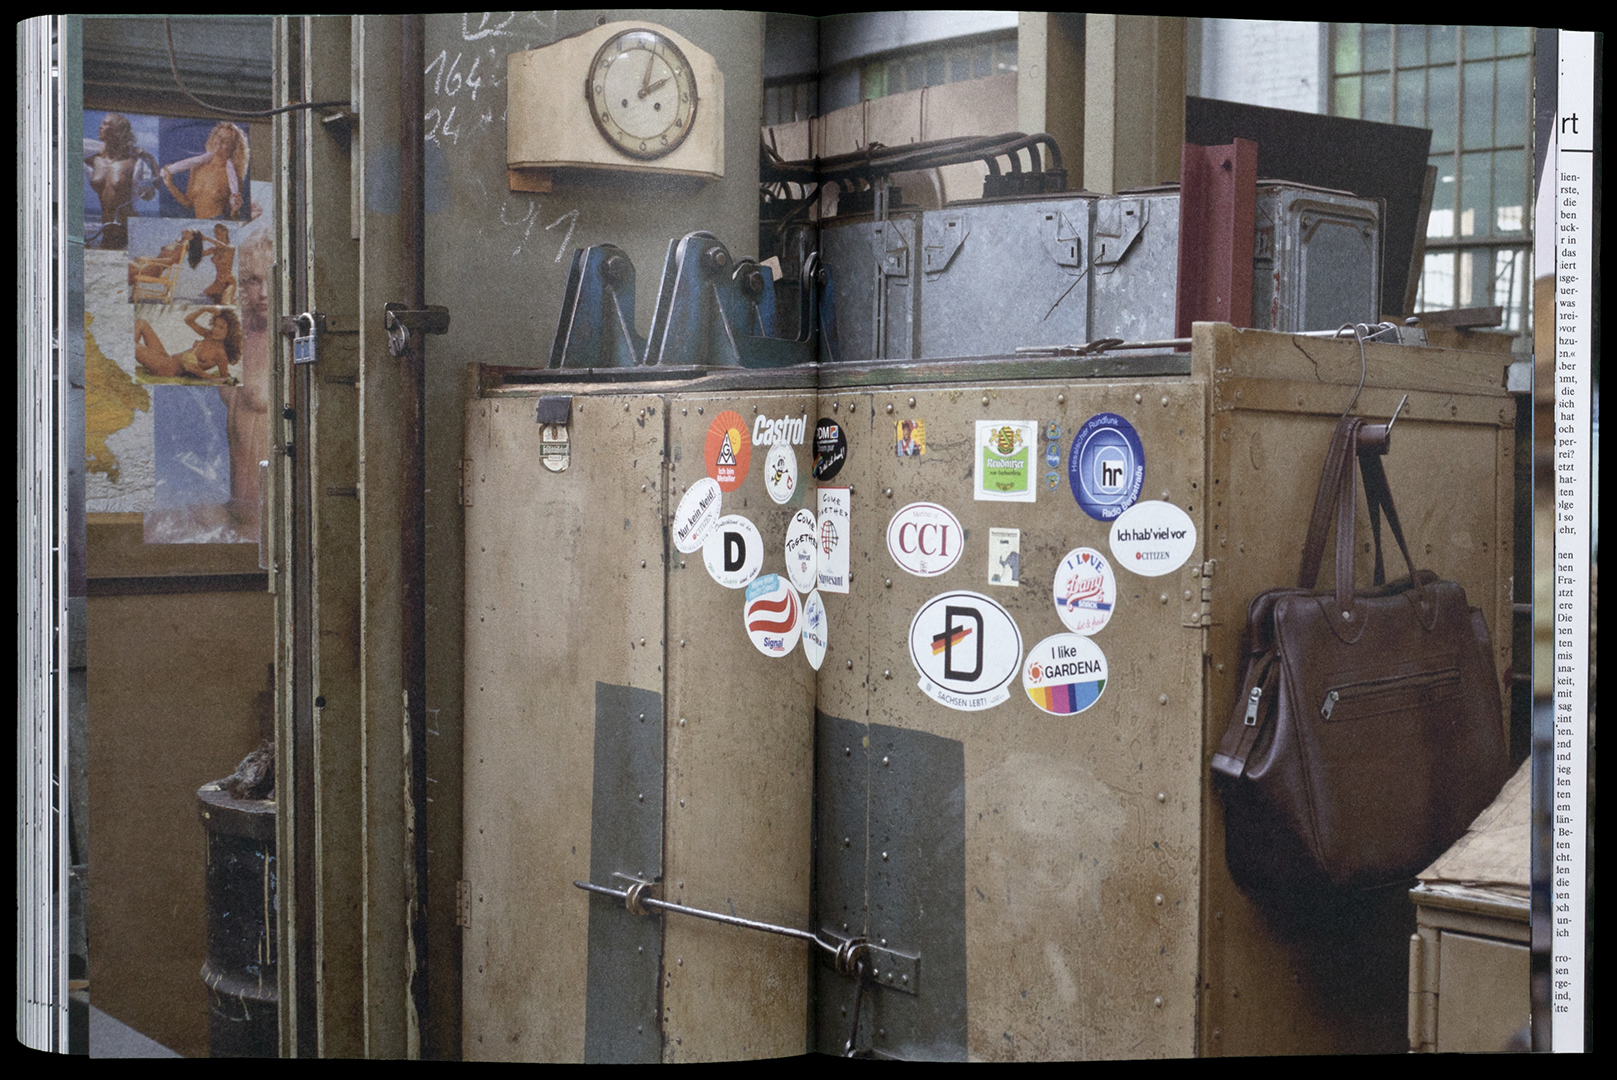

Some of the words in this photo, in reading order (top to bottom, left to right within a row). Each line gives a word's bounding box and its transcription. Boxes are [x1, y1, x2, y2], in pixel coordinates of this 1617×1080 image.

[681, 92, 689, 104] 3
[675, 118, 683, 128] 4
[1562, 113, 1578, 134] rt
[661, 134, 668, 146] 5
[639, 140, 647, 152] 6
[1560, 186, 1580, 195] rste,
[1562, 197, 1577, 207] die
[1560, 210, 1577, 220] ben
[1560, 222, 1580, 232] uck-
[1567, 235, 1577, 245] in
[1561, 248, 1577, 257] das
[1560, 287, 1579, 295] uer-
[1559, 300, 1576, 308] was
[1558, 361, 1577, 371] ber
[1561, 386, 1575, 396] die
[1560, 411, 1575, 421] hat
[1088, 416, 1118, 430] Rundfunk
[752, 414, 807, 446] Castrol
[1559, 439, 1577, 448] per-
[1558, 449, 1575, 459] rei?
[1102, 462, 1123, 486] hr
[1559, 474, 1577, 484] hat-
[1102, 507, 1122, 518] Radio
[1120, 465, 1143, 511] Bergstraße
[822, 493, 841, 506] COME
[677, 523, 690, 540] Nur
[687, 508, 702, 526] kein
[699, 486, 716, 511] Neid!
[796, 512, 815, 532] COME
[1117, 529, 1131, 541] Ich
[1152, 527, 1169, 540] viel
[1170, 530, 1187, 539] vor
[899, 522, 950, 557] CCI
[724, 532, 746, 571] D
[1141, 551, 1170, 560] CITIZEN
[1067, 560, 1074, 570] I
[763, 637, 784, 649] Signal
[944, 605, 984, 682] D
[1558, 639, 1573, 648] ten
[1051, 647, 1055, 659] I
[1058, 645, 1077, 659] like
[1045, 660, 1102, 678] GARDENA
[1557, 688, 1573, 698] mit
[937, 691, 967, 707] SACHSEN
[969, 697, 987, 707] LEBT!
[1557, 703, 1573, 713] sag
[1556, 791, 1571, 799] ten
[1558, 827, 1574, 837] Be-
[1556, 841, 1571, 849] ten
[1555, 852, 1573, 862] cht.
[1555, 877, 1570, 887] die
[1556, 917, 1572, 925] un-
